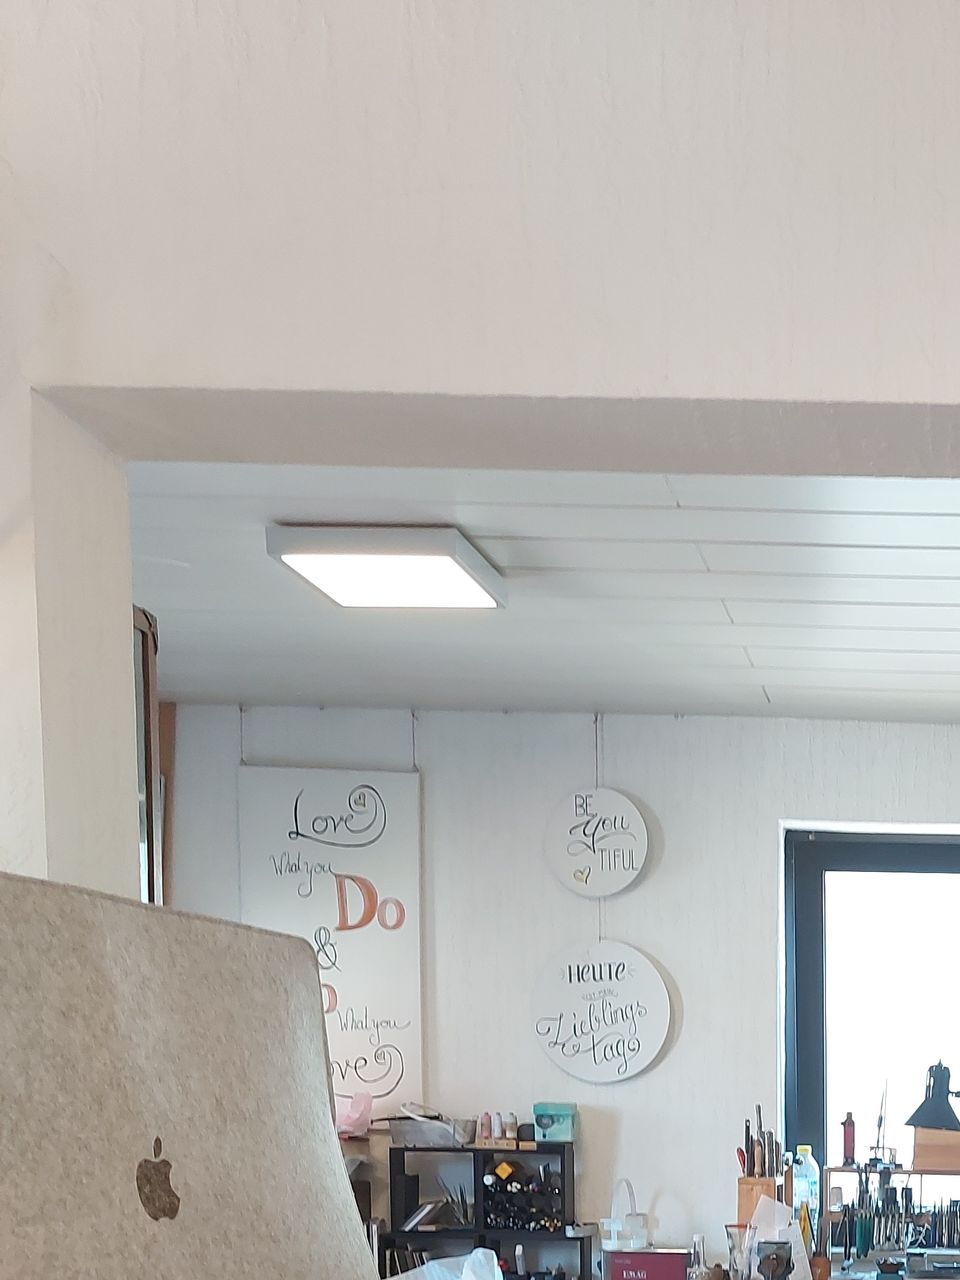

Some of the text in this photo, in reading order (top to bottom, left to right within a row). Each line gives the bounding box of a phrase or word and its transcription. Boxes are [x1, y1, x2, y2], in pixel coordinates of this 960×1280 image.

[288, 784, 387, 848] Love
[574, 794, 593, 817] BE
[599, 847, 640, 871] TIFUL
[334, 873, 406, 931] Do
